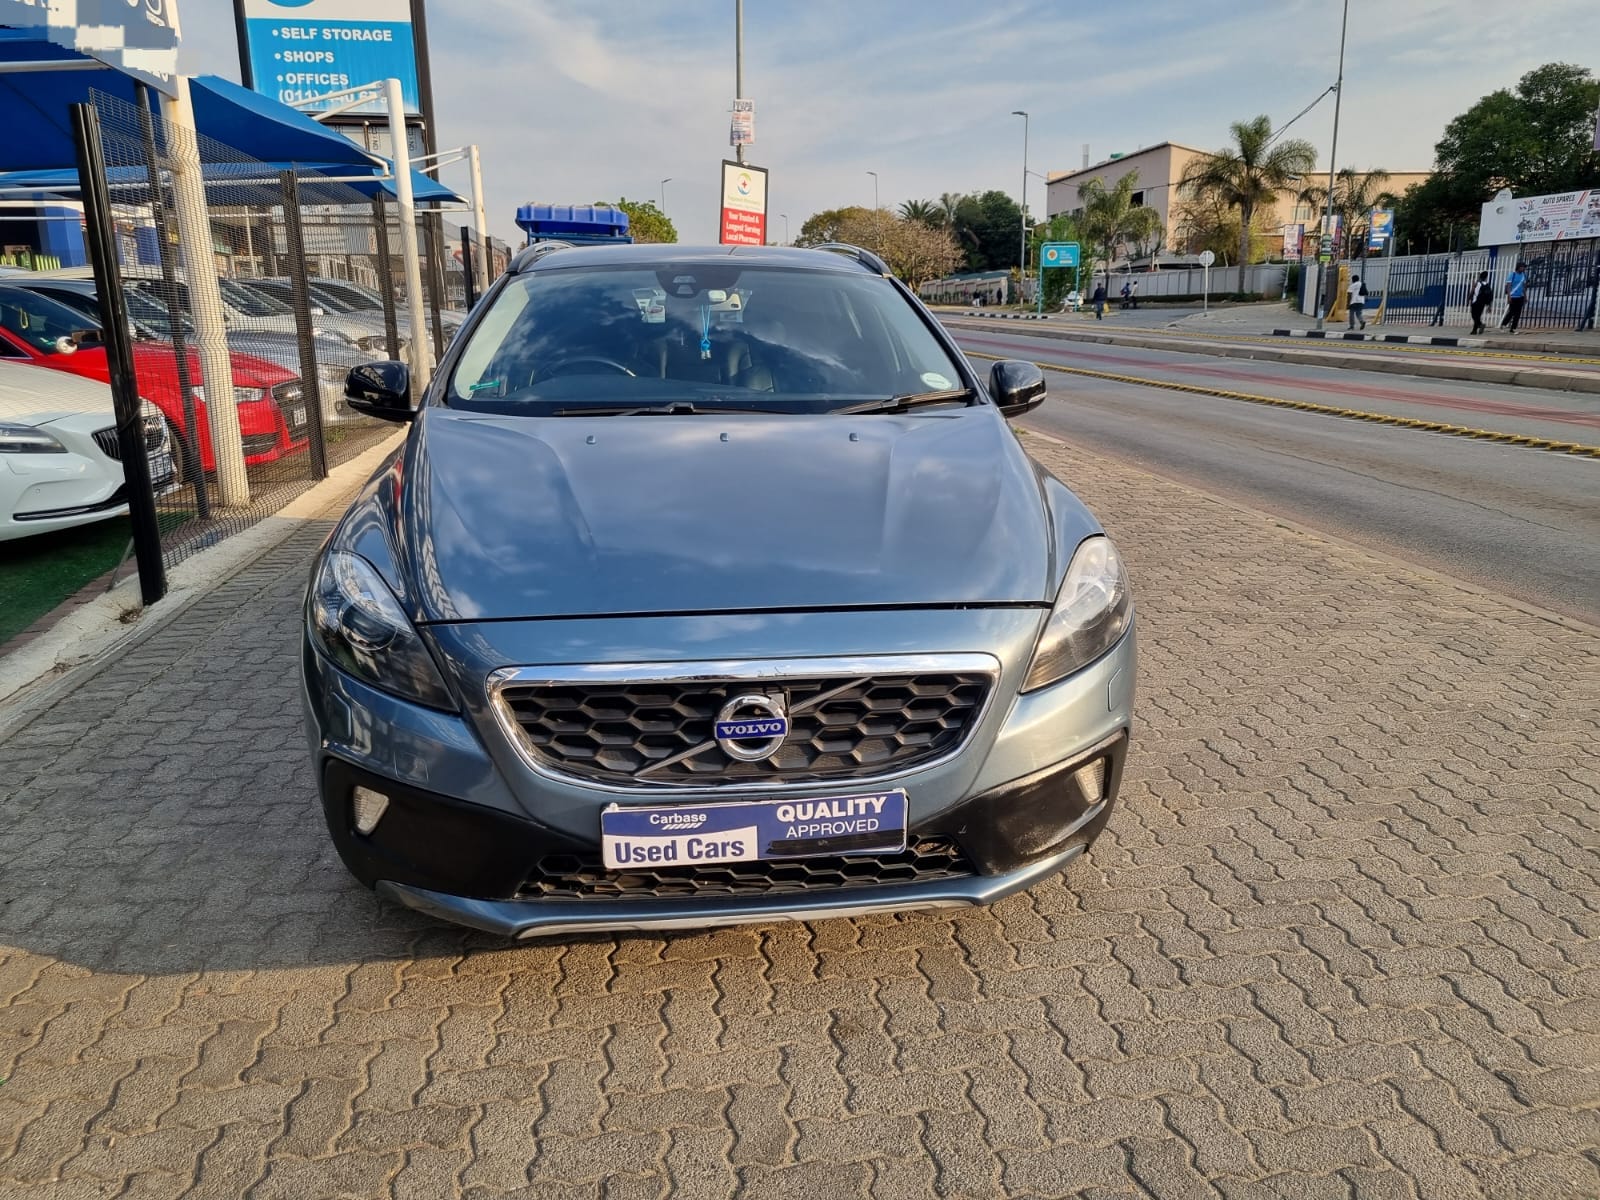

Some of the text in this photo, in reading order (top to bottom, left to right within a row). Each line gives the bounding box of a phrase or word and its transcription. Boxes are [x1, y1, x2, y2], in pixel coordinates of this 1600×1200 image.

[281, 27, 393, 41] SELF STORAGE
[283, 51, 335, 63] SHOPS
[285, 73, 349, 85] OFFICES
[726, 231, 739, 241] Local
[720, 722, 782, 735] VOLVO
[776, 796, 887, 823] QUALITY
[649, 813, 707, 825] Carbase
[786, 818, 879, 839] APPROVED
[615, 838, 745, 864] Used Cars
